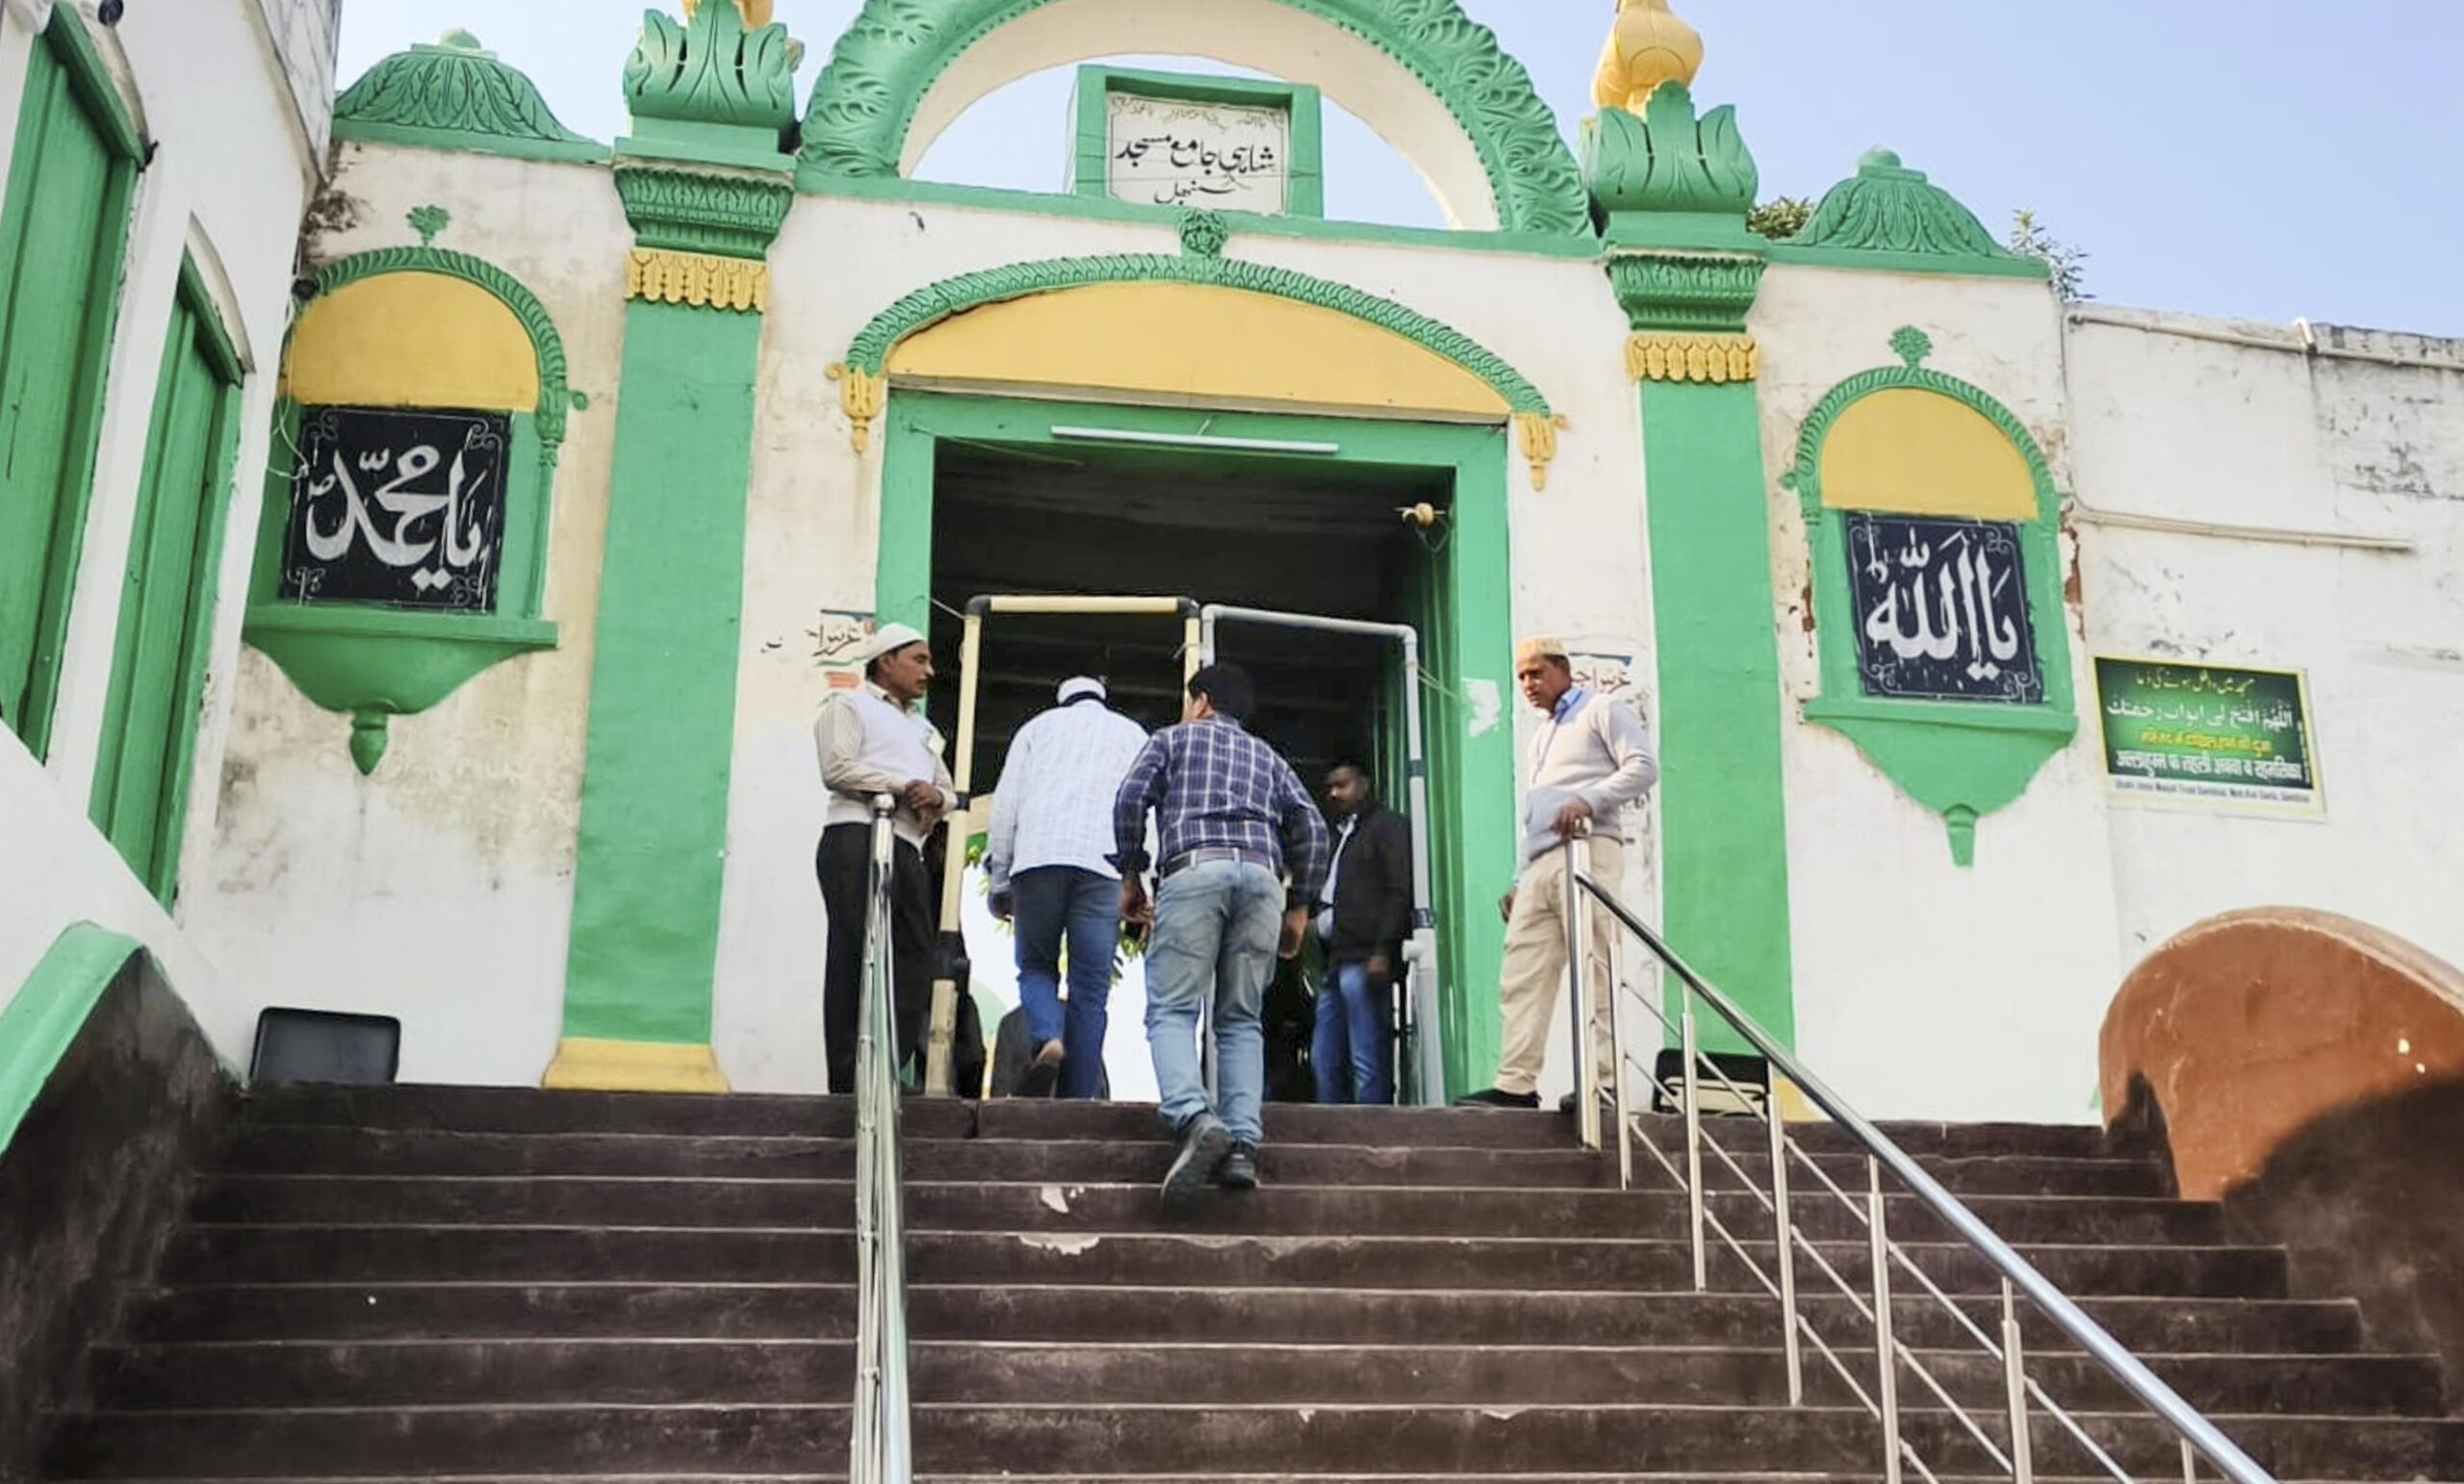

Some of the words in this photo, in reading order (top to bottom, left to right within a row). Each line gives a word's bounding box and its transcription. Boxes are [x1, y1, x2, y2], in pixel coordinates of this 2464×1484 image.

[1115, 134, 1171, 167] مسجد
[1169, 140, 1218, 175] جامع
[1219, 143, 1275, 174] شاہی
